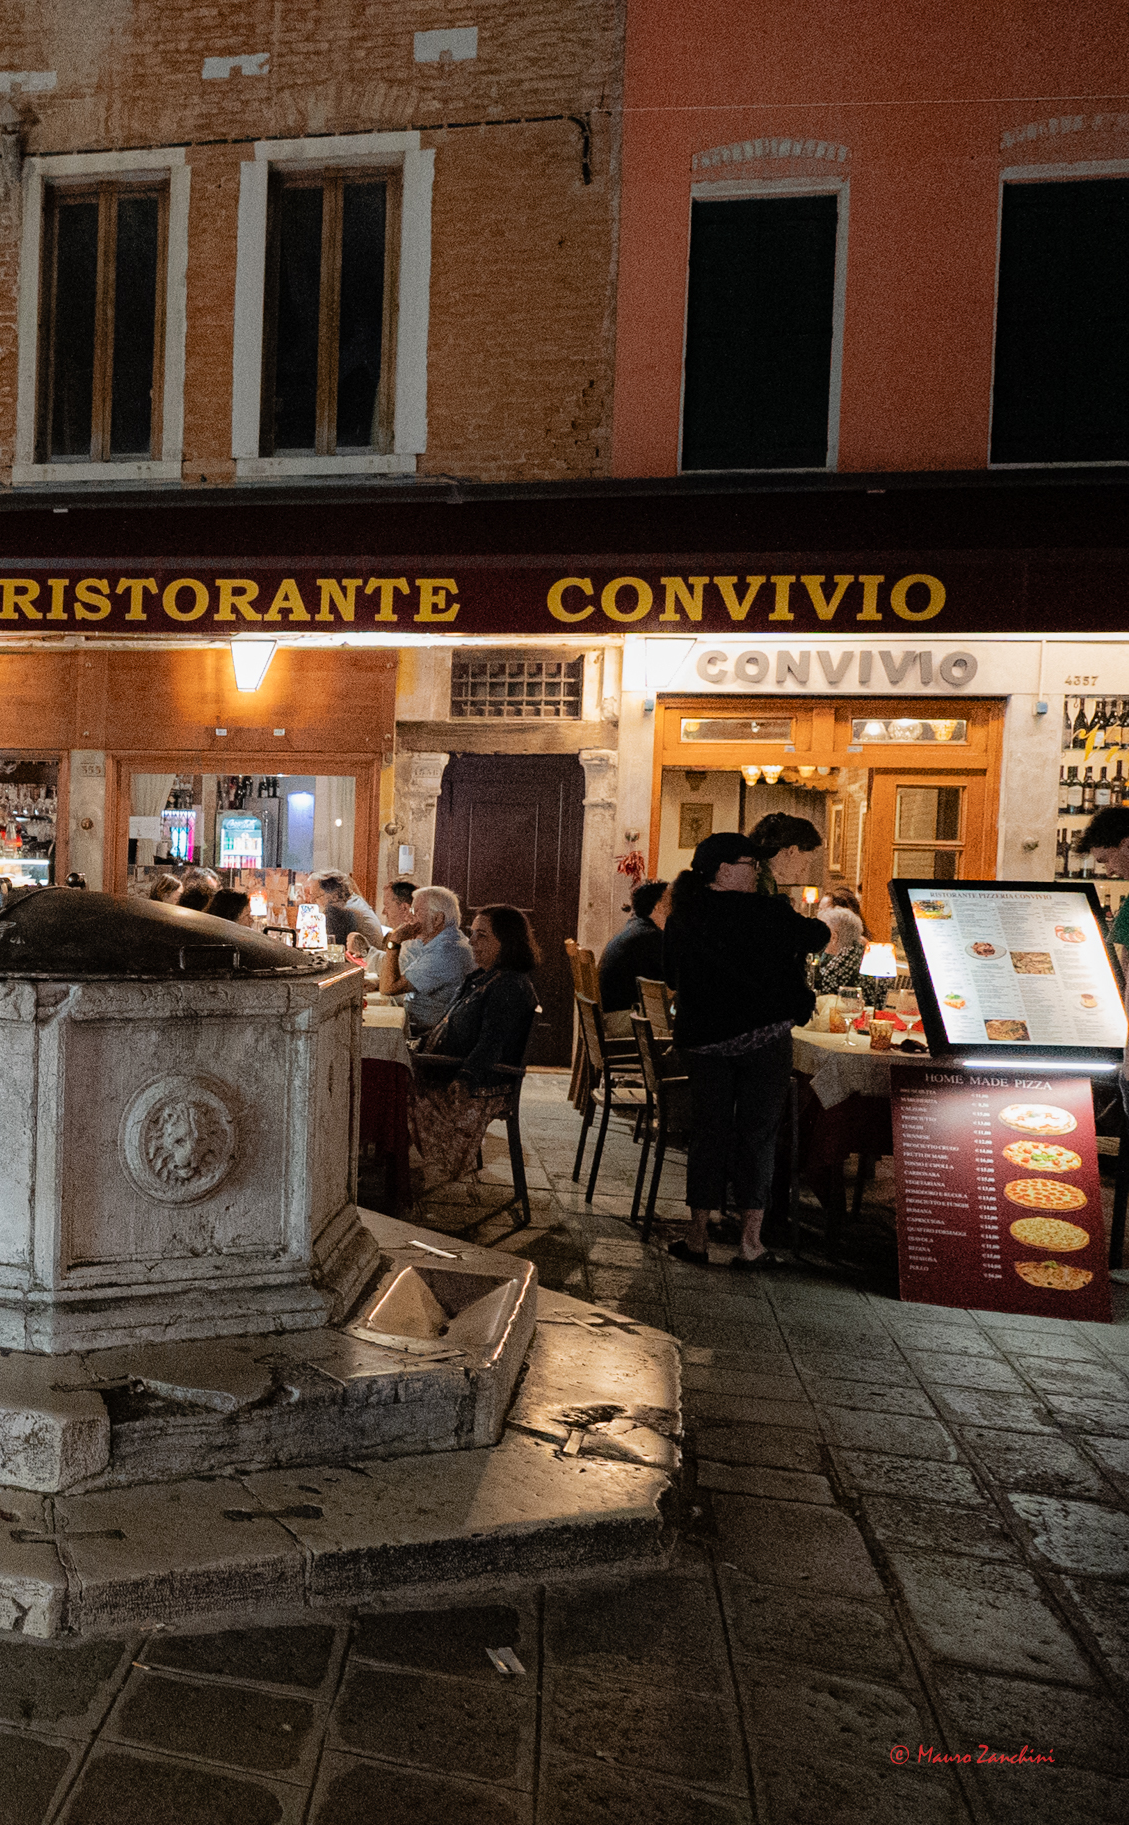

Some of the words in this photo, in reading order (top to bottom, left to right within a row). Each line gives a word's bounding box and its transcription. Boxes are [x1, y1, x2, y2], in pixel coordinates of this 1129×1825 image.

[546, 573, 947, 623] CONVIVIO
[696, 650, 978, 687] CONVIVIO
[1063, 675, 1100, 687] 4357
[930, 891, 977, 899] RISTORANTE
[925, 1073, 964, 1085] HOME
[970, 1076, 1009, 1088] MADE
[1014, 1079, 1053, 1091] PIZZA
